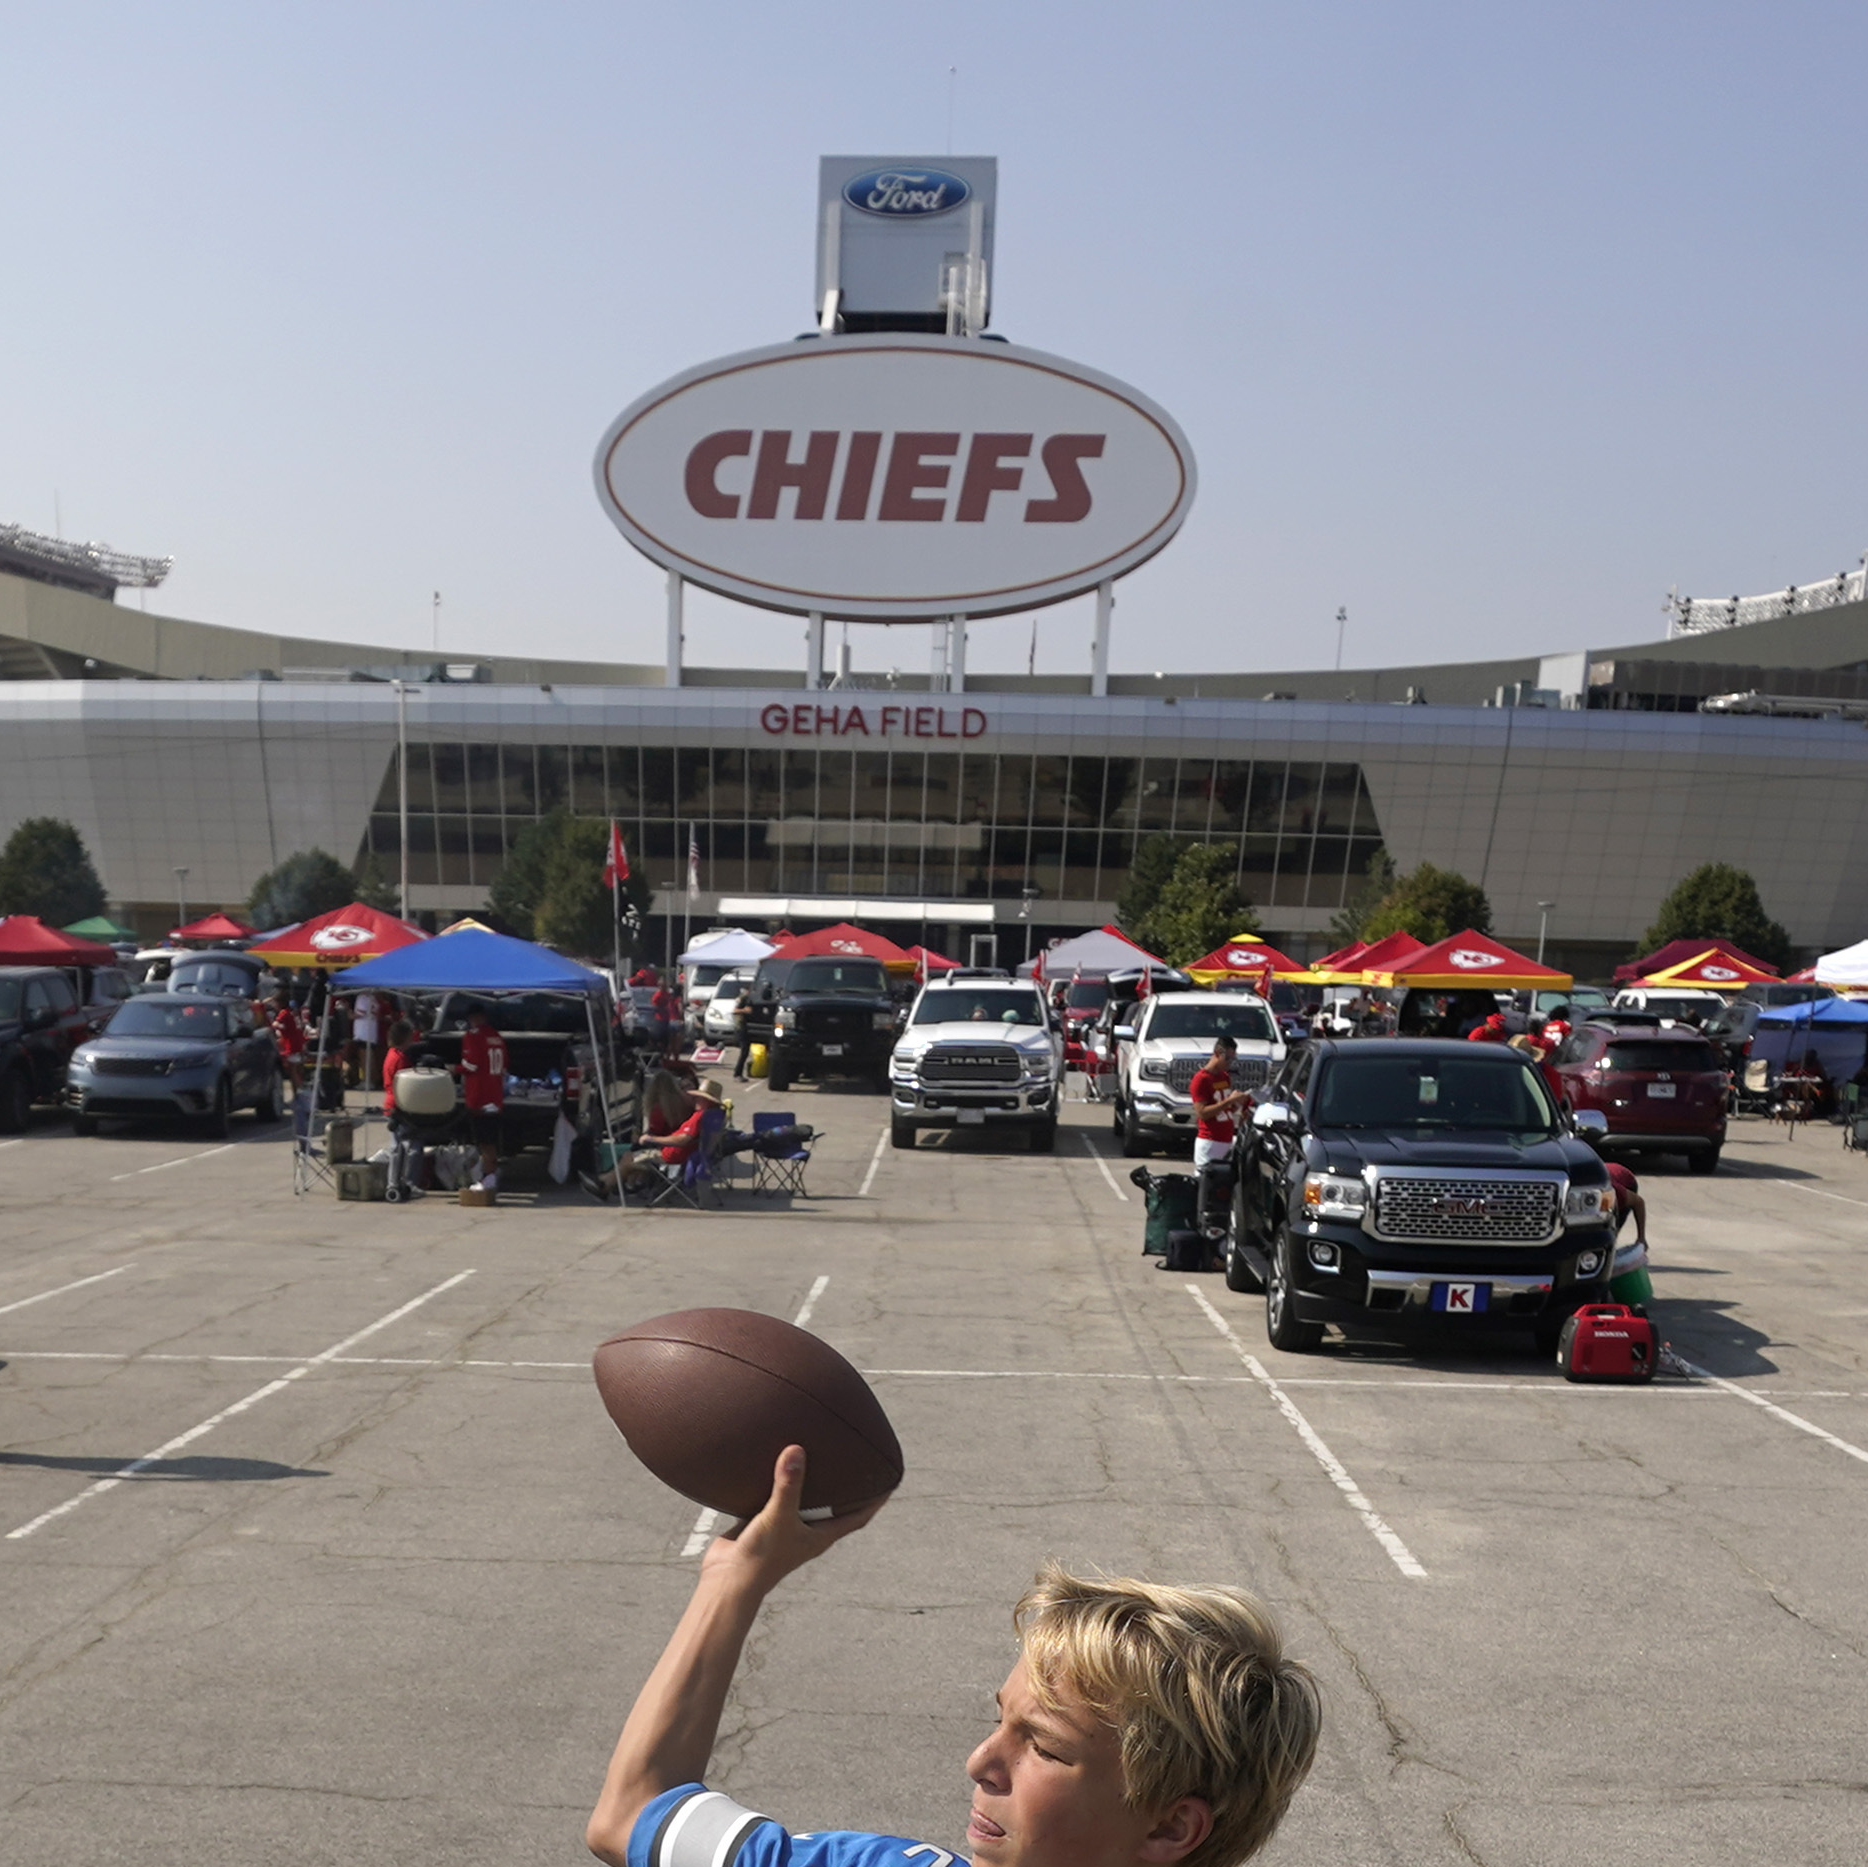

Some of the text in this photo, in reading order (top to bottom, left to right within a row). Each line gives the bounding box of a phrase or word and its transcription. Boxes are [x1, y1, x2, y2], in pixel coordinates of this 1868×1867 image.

[866, 172, 946, 214] Ford
[684, 429, 1107, 524] CHIEFS
[760, 703, 989, 740] GEHA FIELD
[487, 1047, 504, 1075] 10
[950, 1056, 993, 1066] RAM
[1432, 1198, 1505, 1216] GMC
[1449, 1288, 1472, 1309] K
[1593, 1330, 1630, 1339] HONDA
